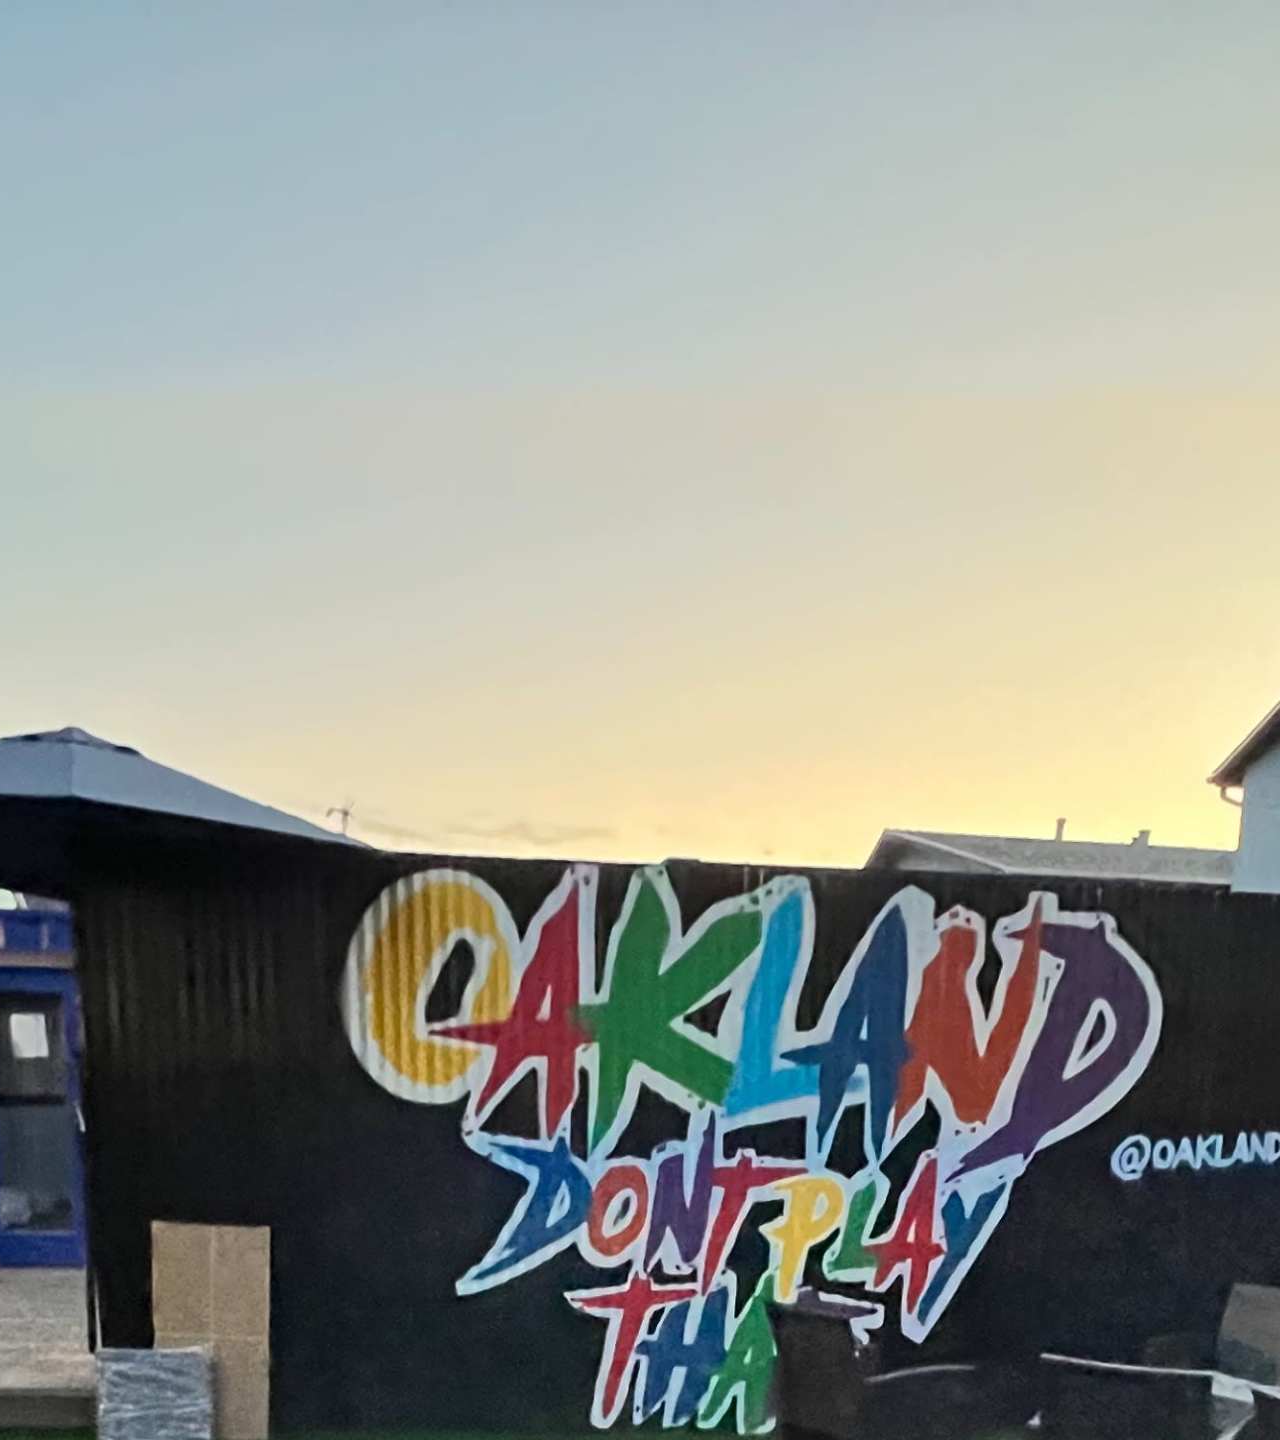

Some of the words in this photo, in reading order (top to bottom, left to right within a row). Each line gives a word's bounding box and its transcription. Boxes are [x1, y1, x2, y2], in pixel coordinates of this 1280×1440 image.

[342, 863, 1164, 1188] OAKLAND
[455, 1120, 812, 1298] DONT
[758, 1145, 1034, 1345] PLAY
